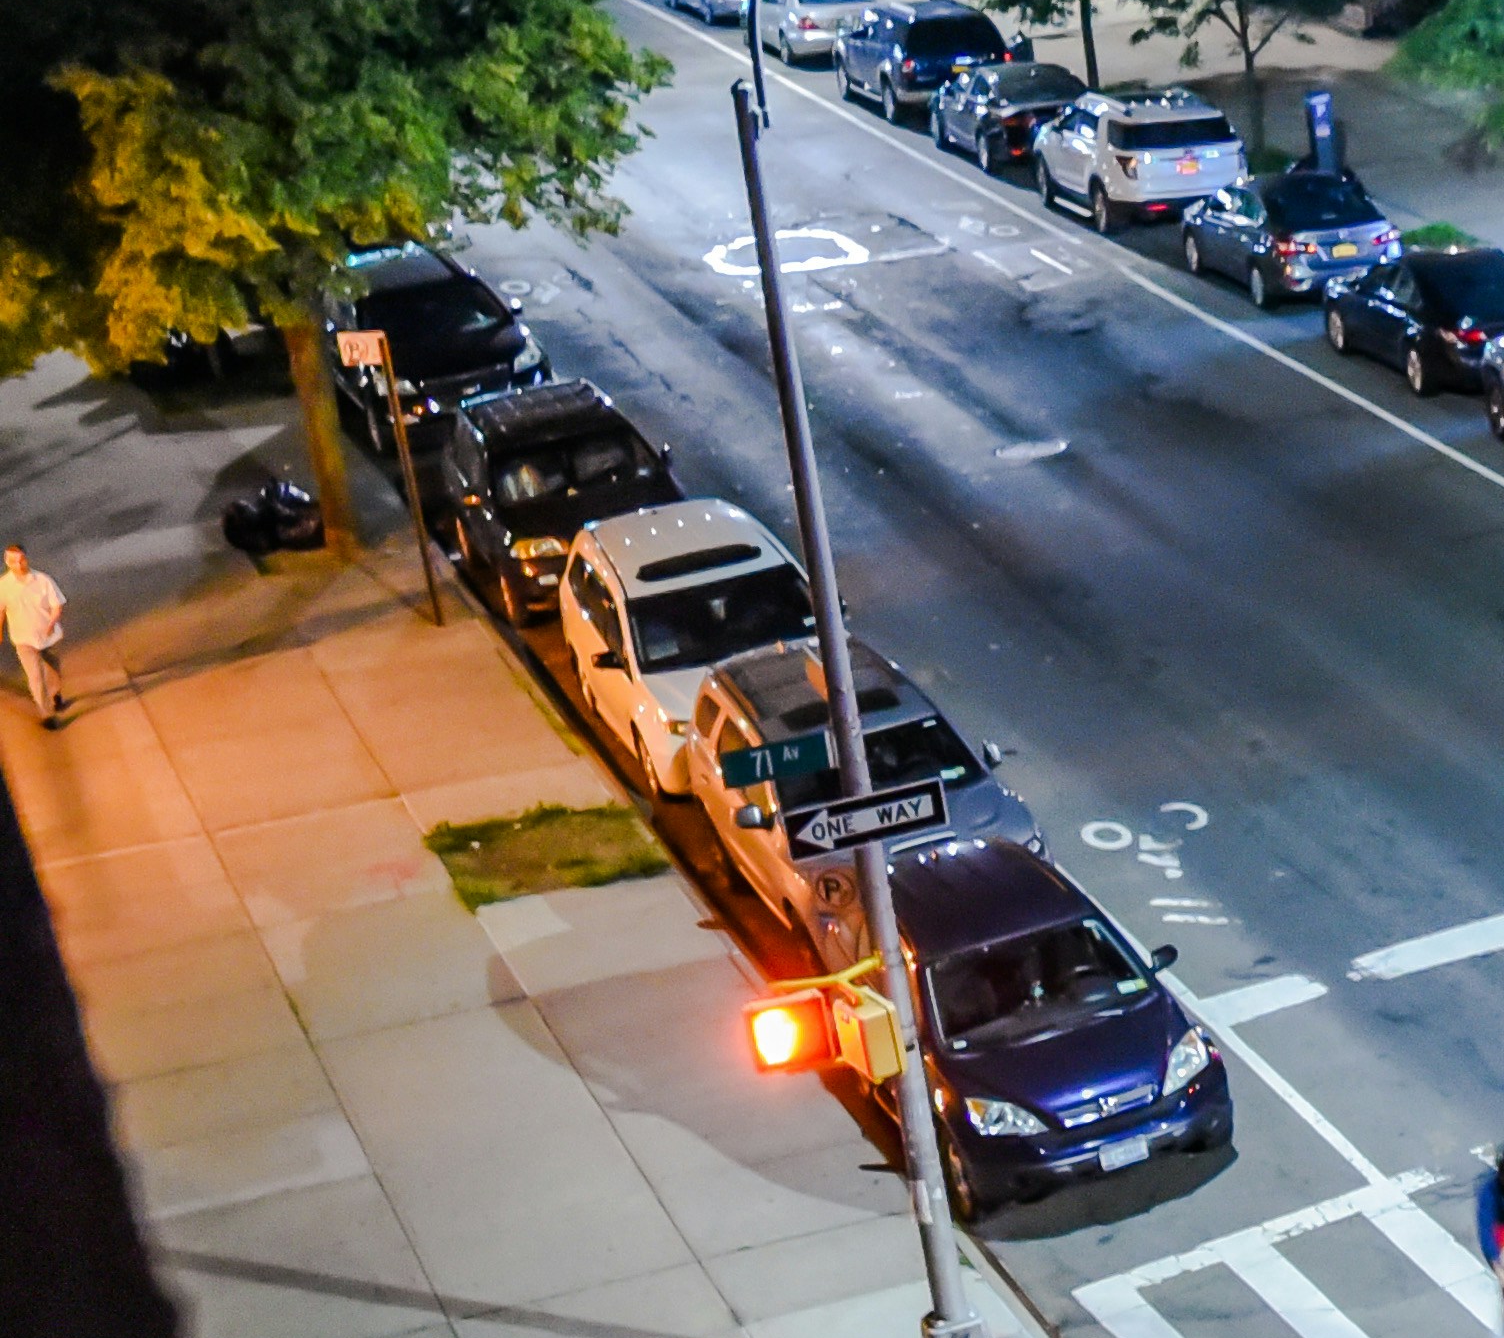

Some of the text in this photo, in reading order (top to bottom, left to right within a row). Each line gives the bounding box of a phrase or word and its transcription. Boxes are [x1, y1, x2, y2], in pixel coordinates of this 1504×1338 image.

[749, 749, 775, 779] 71
[811, 798, 923, 841] ONE WAY
